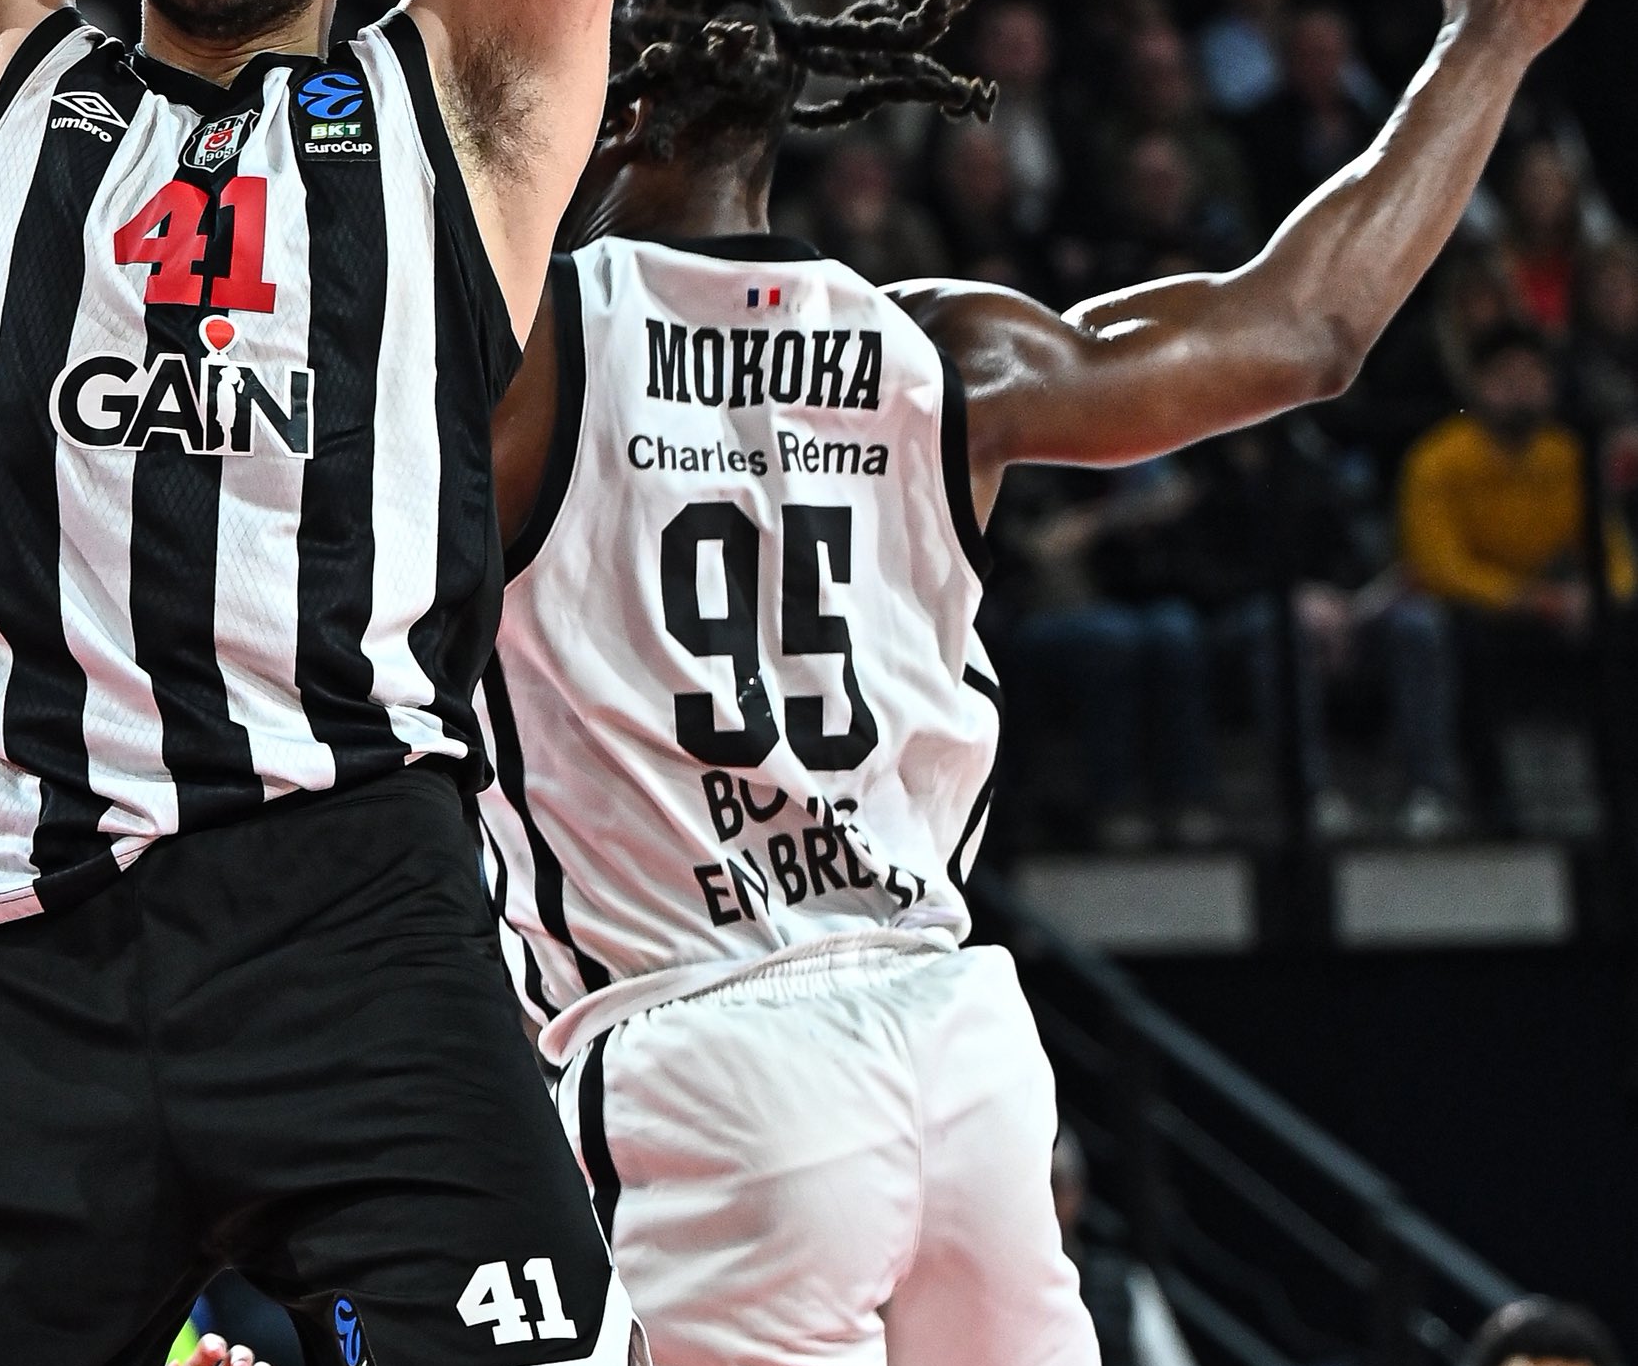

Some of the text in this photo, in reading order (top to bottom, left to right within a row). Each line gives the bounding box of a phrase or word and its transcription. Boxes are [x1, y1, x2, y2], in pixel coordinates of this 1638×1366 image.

[50, 116, 113, 143] umbro
[304, 140, 372, 155] EuroCup
[310, 122, 361, 139] BKT
[113, 175, 277, 315] 41
[645, 317, 883, 411] MOKOKA
[627, 430, 889, 477] Charles Réma
[660, 501, 879, 771] 95
[455, 1256, 578, 1346] 41
